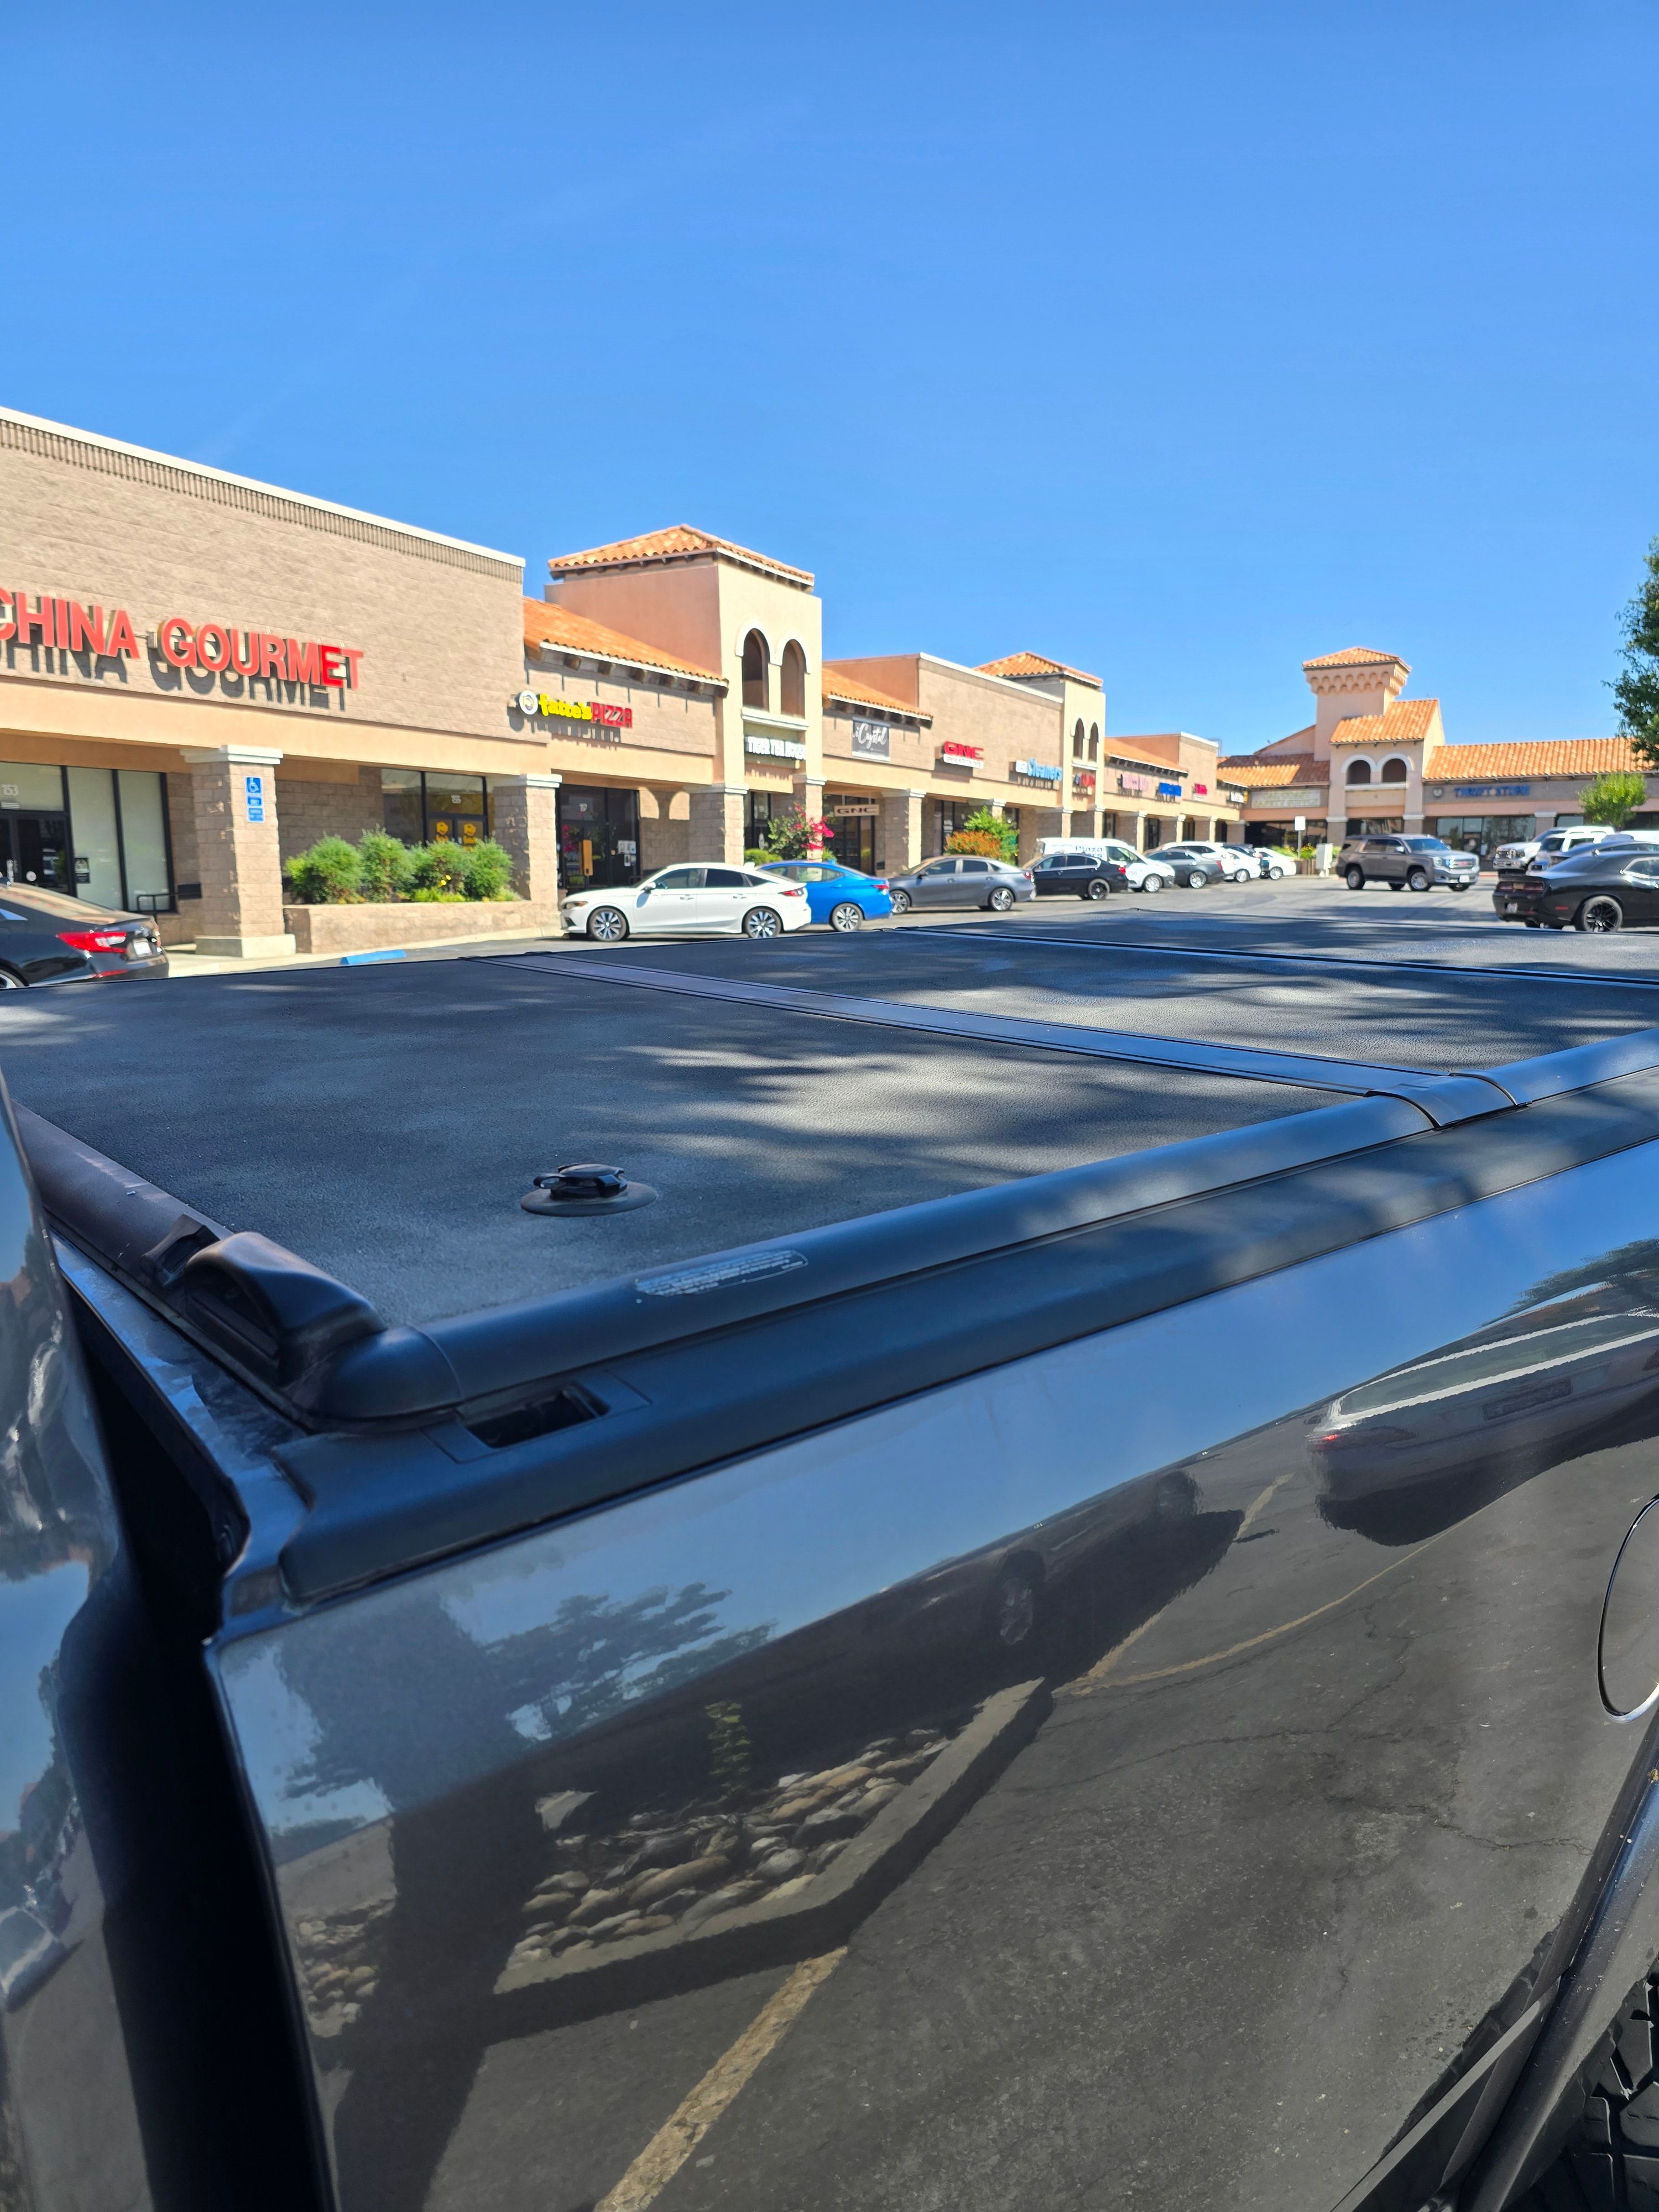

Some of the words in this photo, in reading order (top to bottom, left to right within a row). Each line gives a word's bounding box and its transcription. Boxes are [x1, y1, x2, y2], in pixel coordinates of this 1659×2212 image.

[159, 618, 364, 691] GOURMET
[591, 702, 633, 729] PIZZA
[748, 736, 770, 754] TIGER
[770, 739, 784, 757] TEA
[943, 741, 984, 760] GNC
